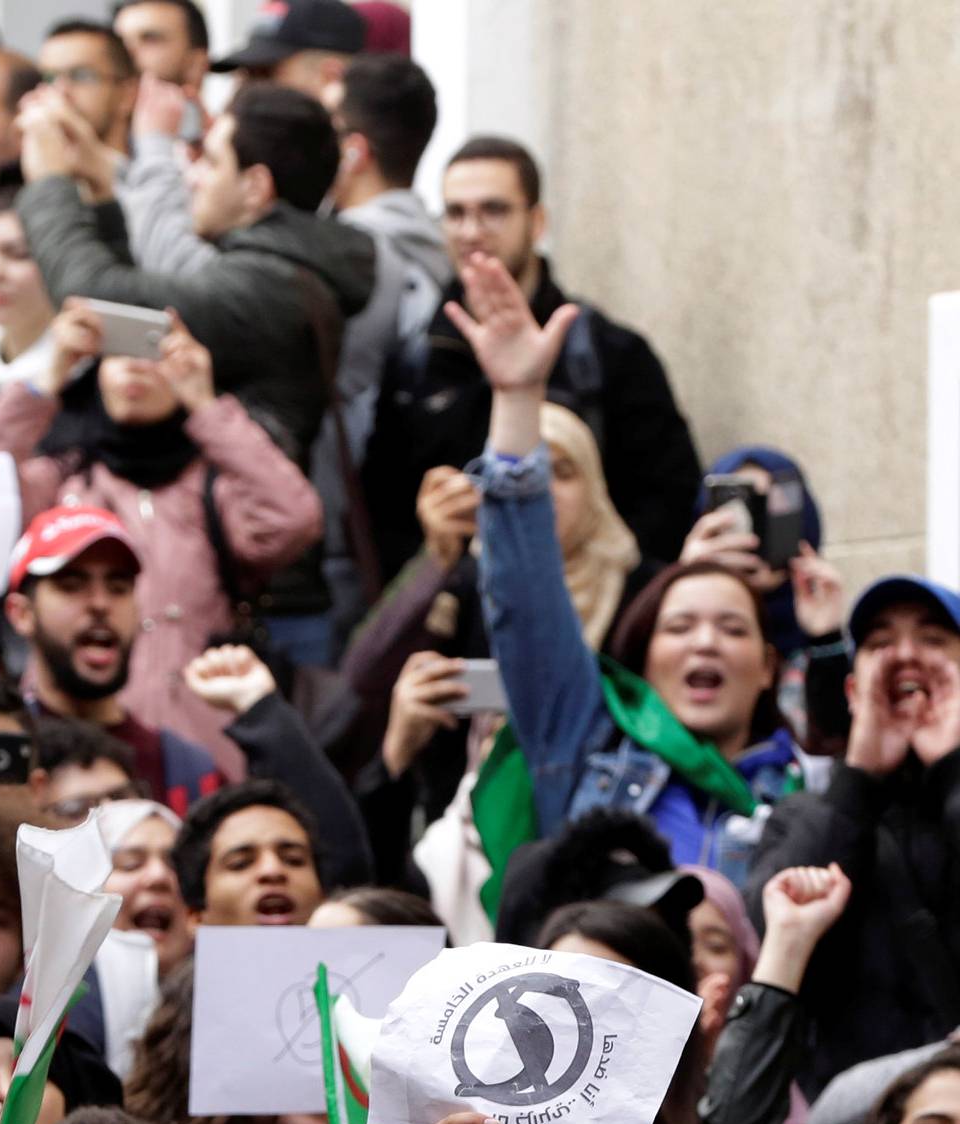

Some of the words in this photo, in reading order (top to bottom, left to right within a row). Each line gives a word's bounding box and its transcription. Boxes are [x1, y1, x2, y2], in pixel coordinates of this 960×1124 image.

[541, 953, 553, 965] لا
[430, 982, 475, 1045] الخامسة
[594, 1034, 618, 1080] ضدها
